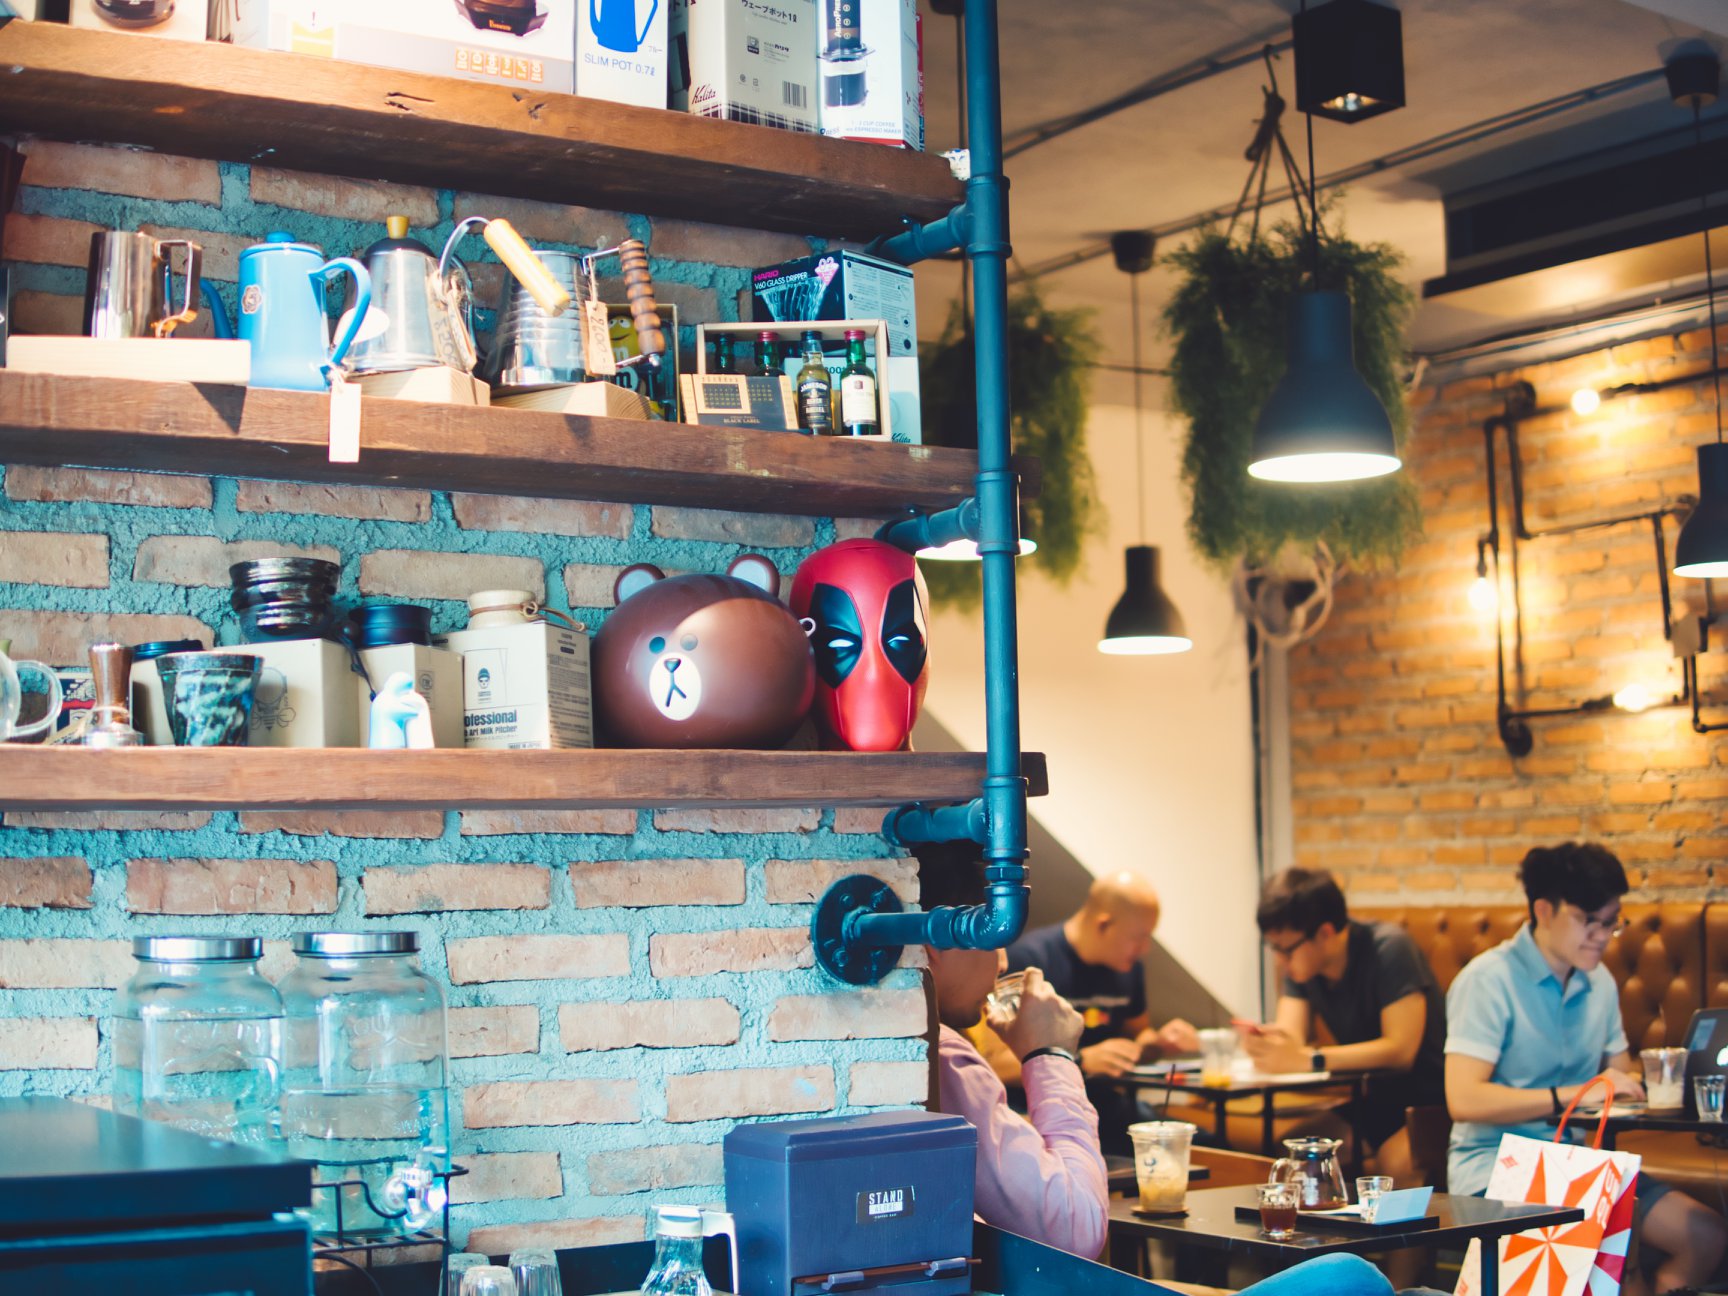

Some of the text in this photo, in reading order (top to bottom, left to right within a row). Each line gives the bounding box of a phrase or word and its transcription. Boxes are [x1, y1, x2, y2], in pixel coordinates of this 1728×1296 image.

[585, 53, 609, 67] SLIM
[612, 59, 632, 71] POT
[691, 83, 716, 104] Kalita
[754, 271, 808, 290] V60 GLASS DRIPPER
[469, 728, 479, 737] Art
[480, 726, 494, 735] Milk
[495, 725, 518, 734] Pitcher
[869, 1189, 903, 1205] STAND
